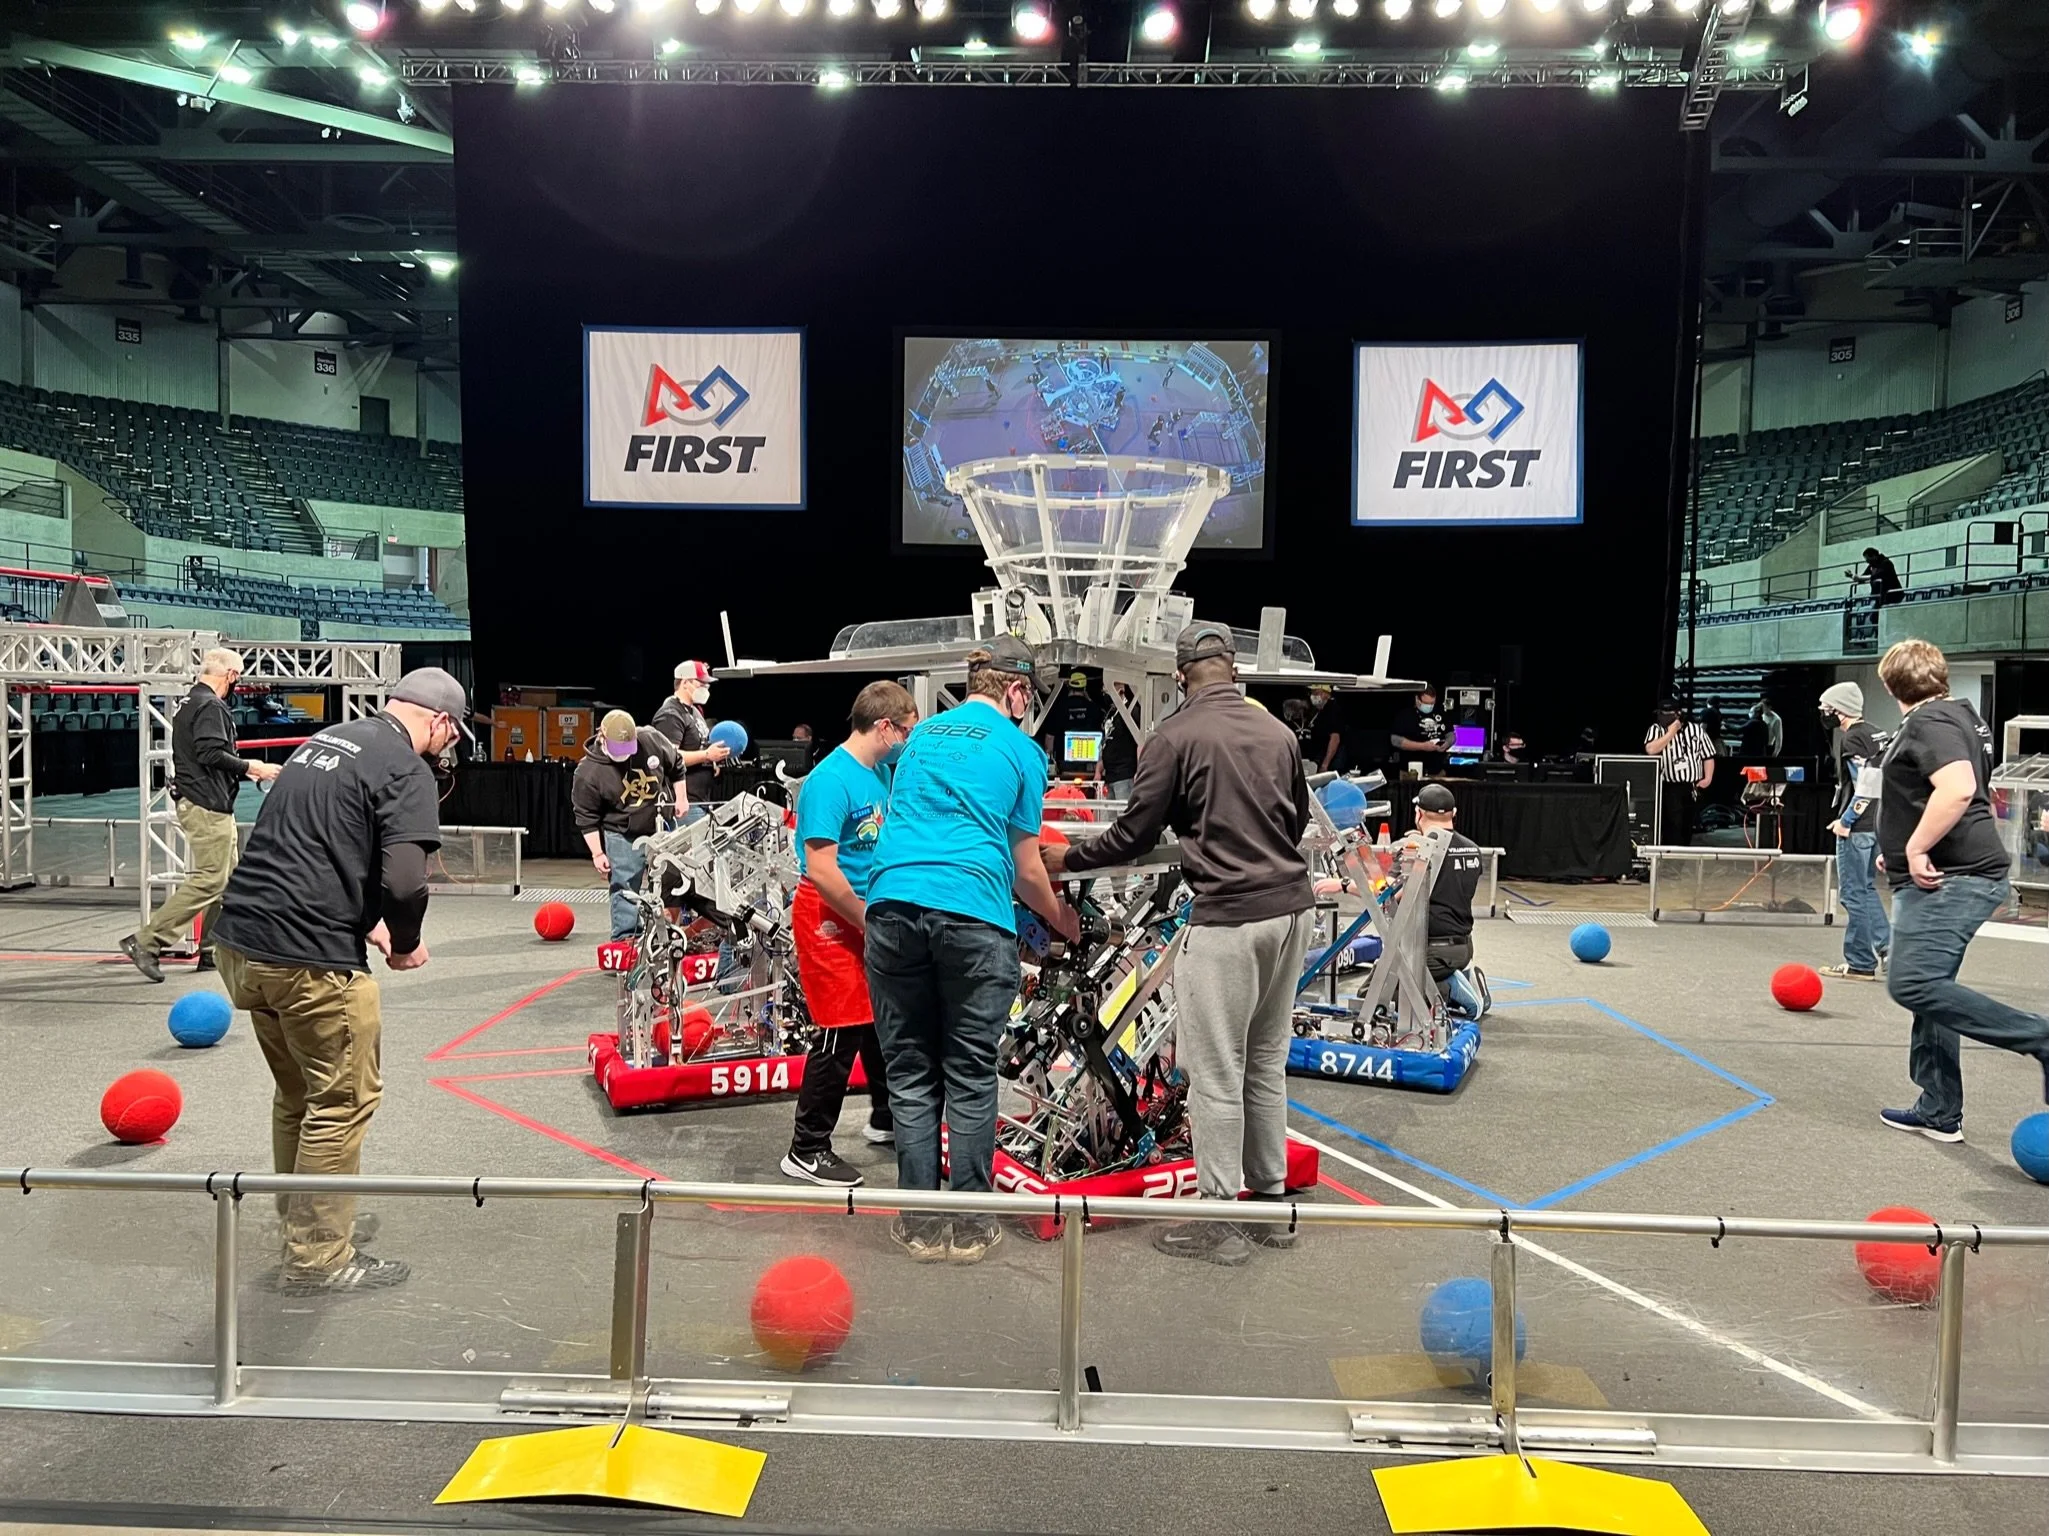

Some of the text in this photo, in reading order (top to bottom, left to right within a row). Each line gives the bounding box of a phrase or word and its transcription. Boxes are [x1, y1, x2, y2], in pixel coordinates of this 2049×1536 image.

[118, 331, 140, 342] 335
[1831, 350, 1852, 361] 305
[316, 363, 335, 373] 336
[624, 435, 766, 474] FIRST
[1393, 449, 1541, 489] FIRST
[918, 724, 992, 740] 2826
[603, 948, 622, 969] 37
[694, 958, 719, 980] 37
[1320, 1051, 1394, 1083] 8744
[711, 1062, 789, 1096] 5914
